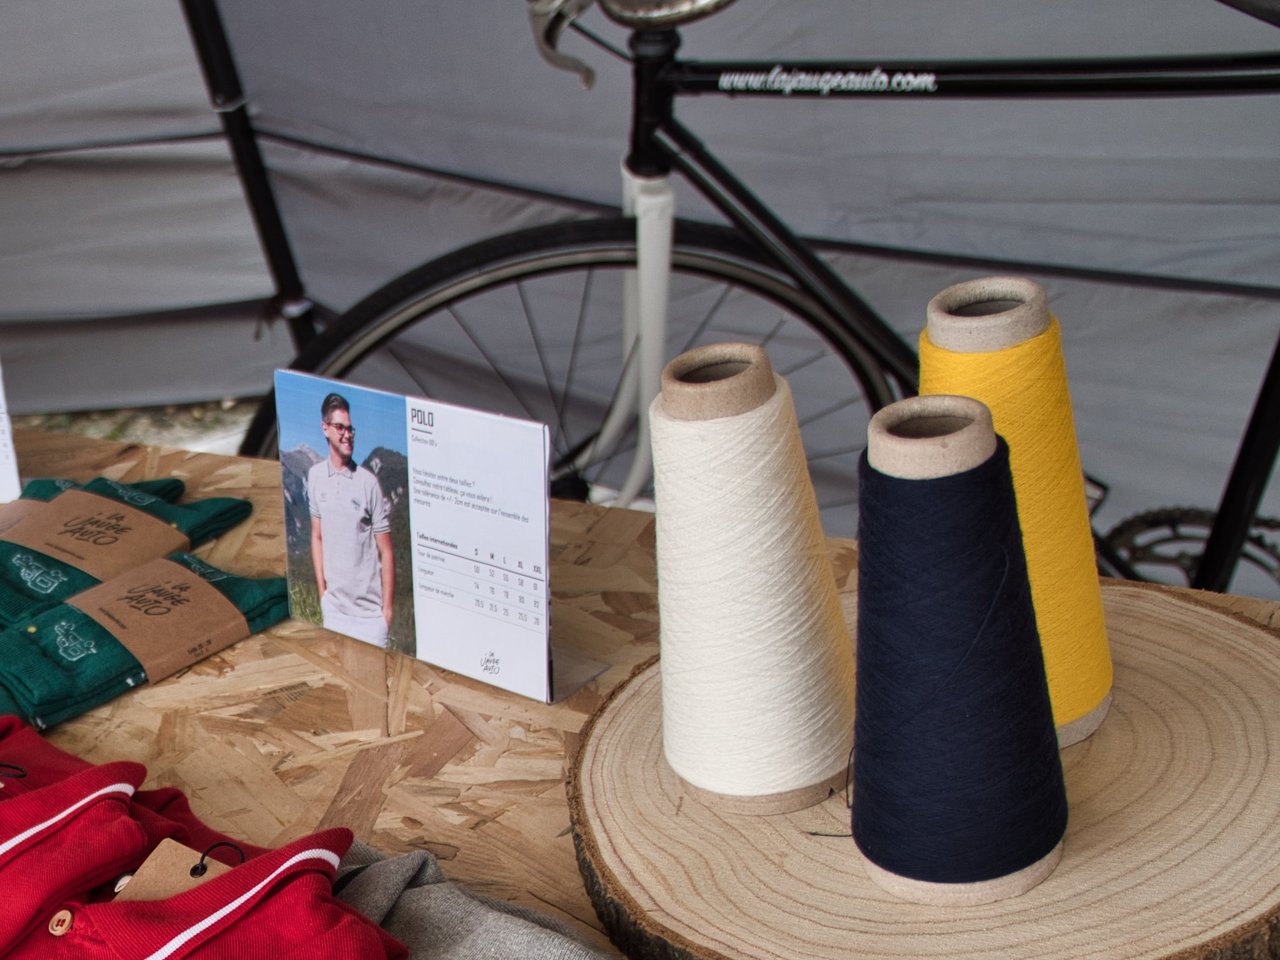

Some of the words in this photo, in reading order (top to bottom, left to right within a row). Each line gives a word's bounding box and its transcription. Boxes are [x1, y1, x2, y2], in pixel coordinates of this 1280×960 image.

[719, 64, 937, 95] www.lajaugeauto.com
[411, 408, 434, 427] POLO
[57, 527, 119, 546] AUTO
[116, 593, 171, 616] AUTO
